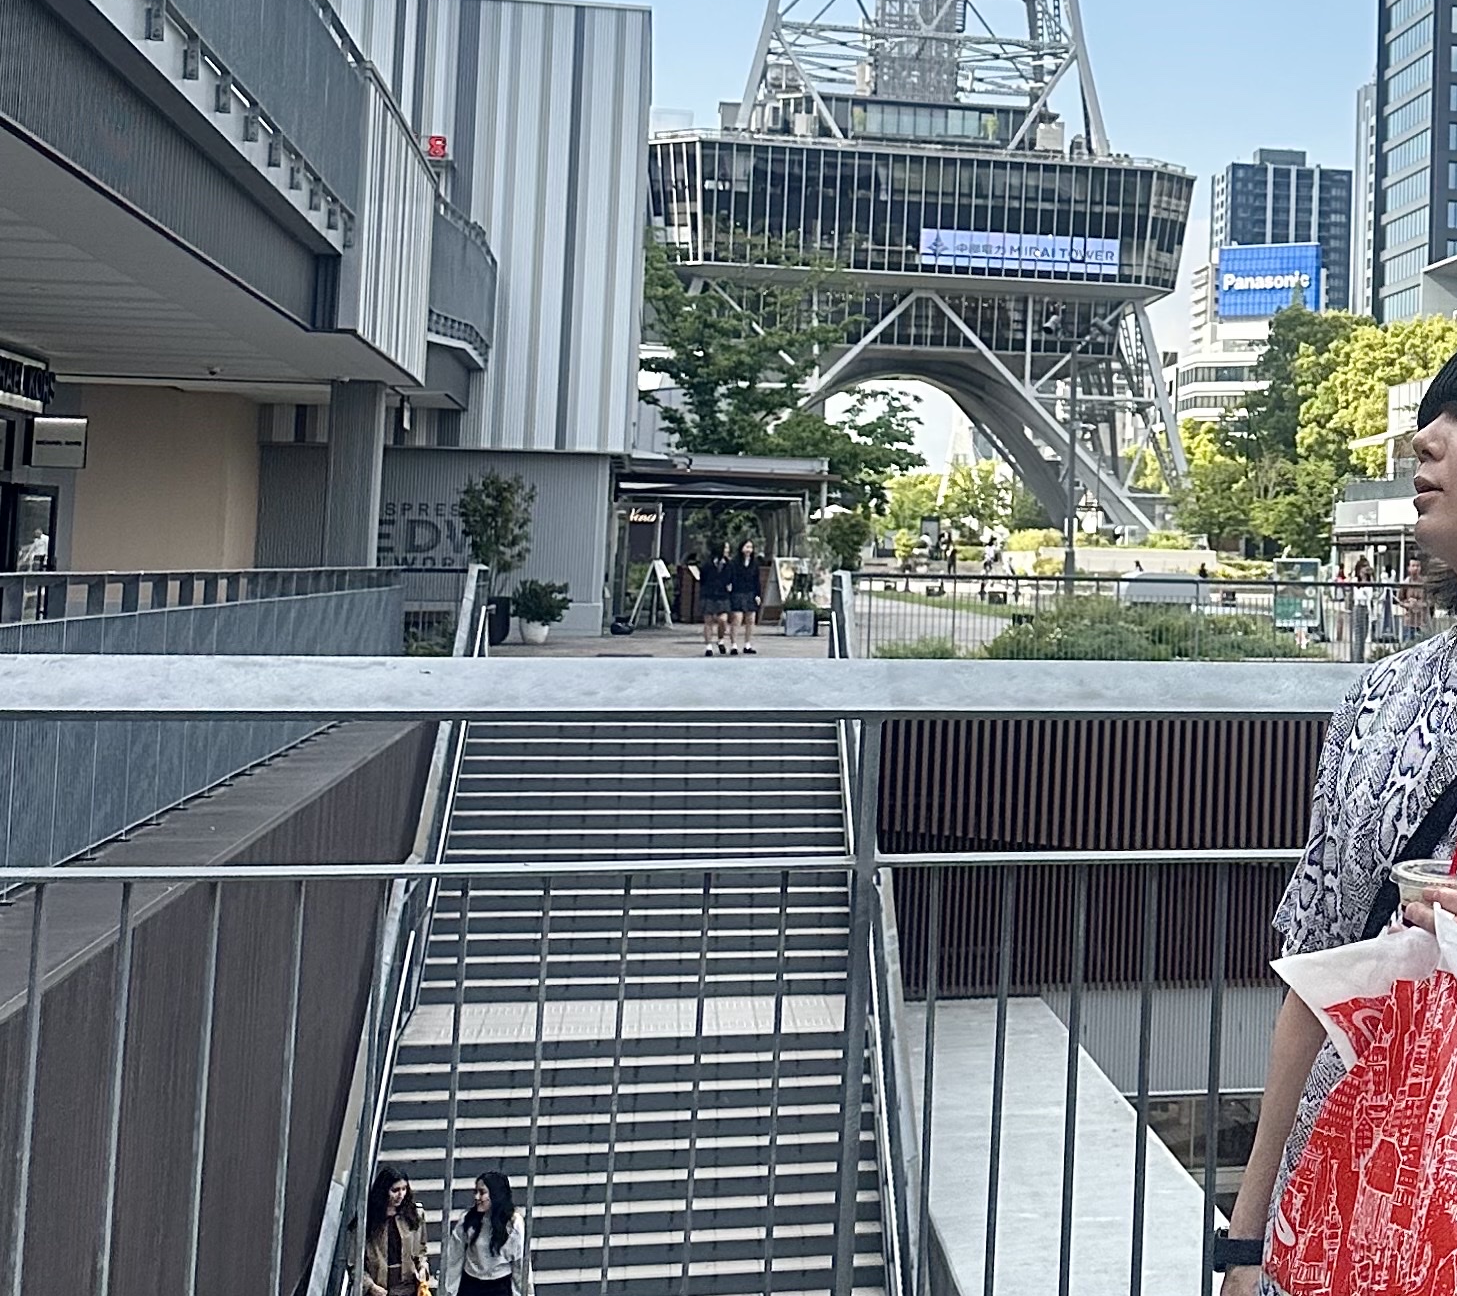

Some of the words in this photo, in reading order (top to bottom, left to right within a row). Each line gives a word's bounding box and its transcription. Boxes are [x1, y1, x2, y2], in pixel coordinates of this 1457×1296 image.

[1010, 245, 1055, 259] MIRAI
[1059, 247, 1115, 261] TOWER
[1222, 270, 1310, 291] Panasonic
